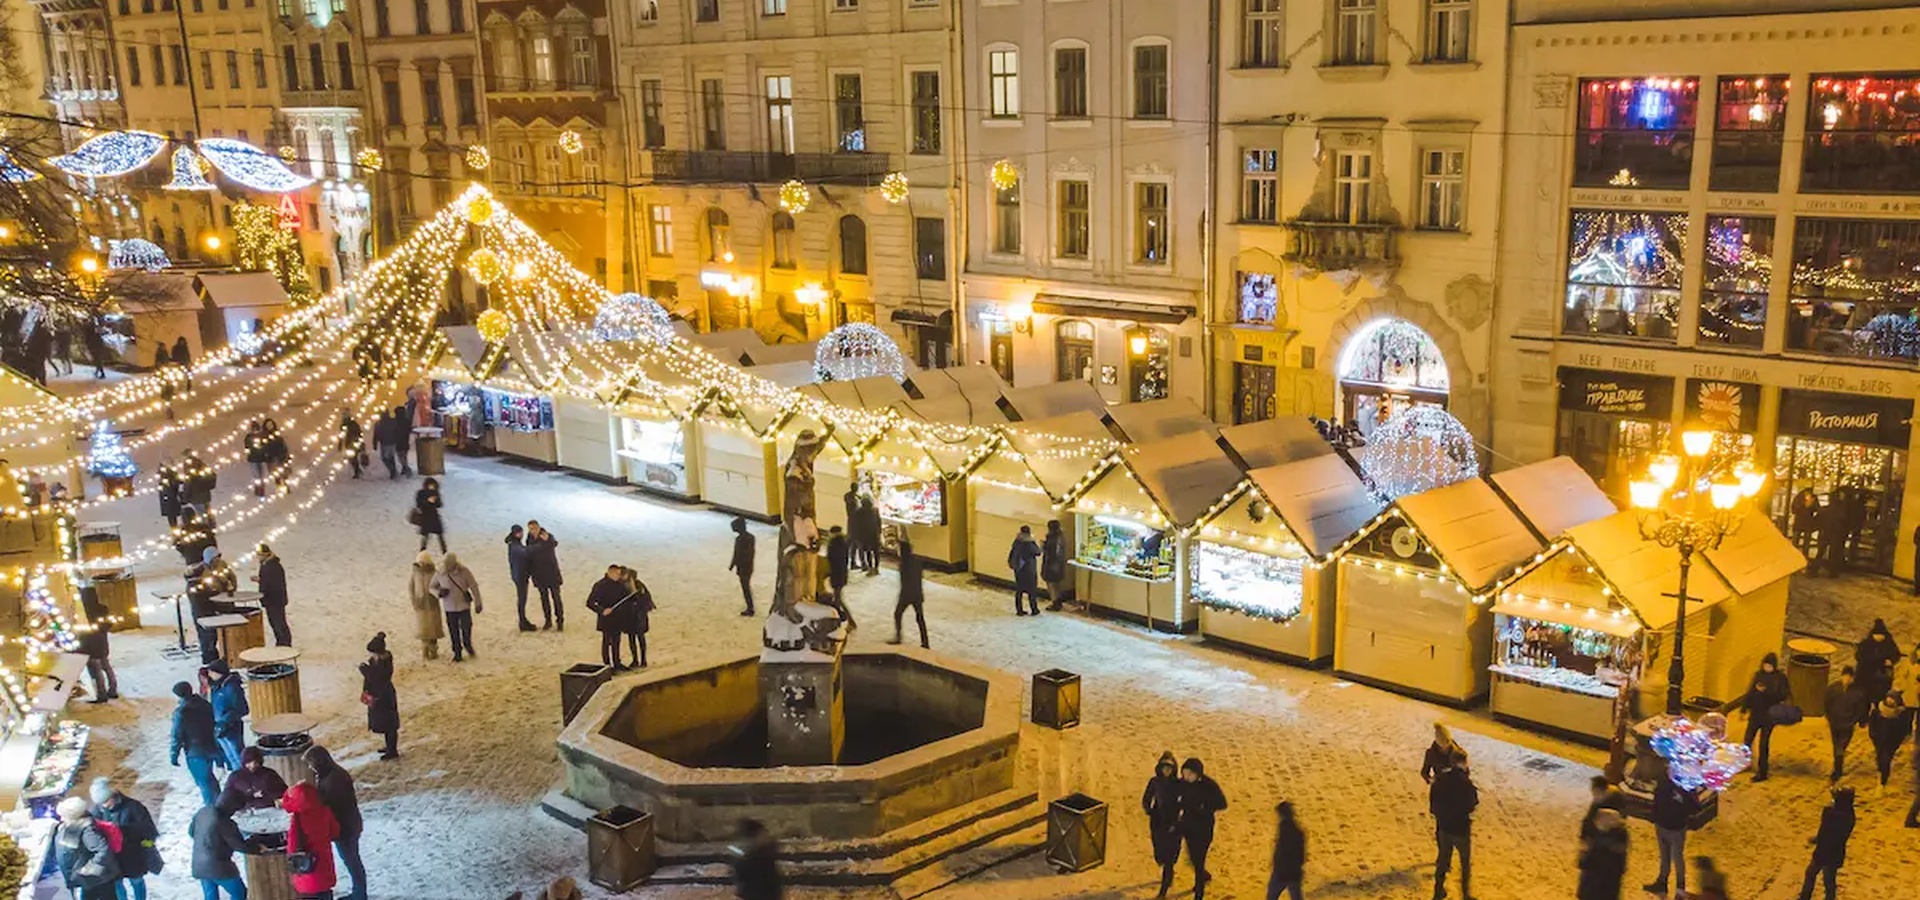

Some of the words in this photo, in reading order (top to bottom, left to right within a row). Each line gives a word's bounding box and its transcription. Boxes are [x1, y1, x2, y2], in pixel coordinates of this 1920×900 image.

[1579, 354, 1601, 366] BEER
[1613, 357, 1656, 372] THEATRE
[1693, 364, 1724, 377] ТЕАТР
[1732, 368, 1758, 381] ПИВА
[1860, 379, 1892, 394] BIERS
